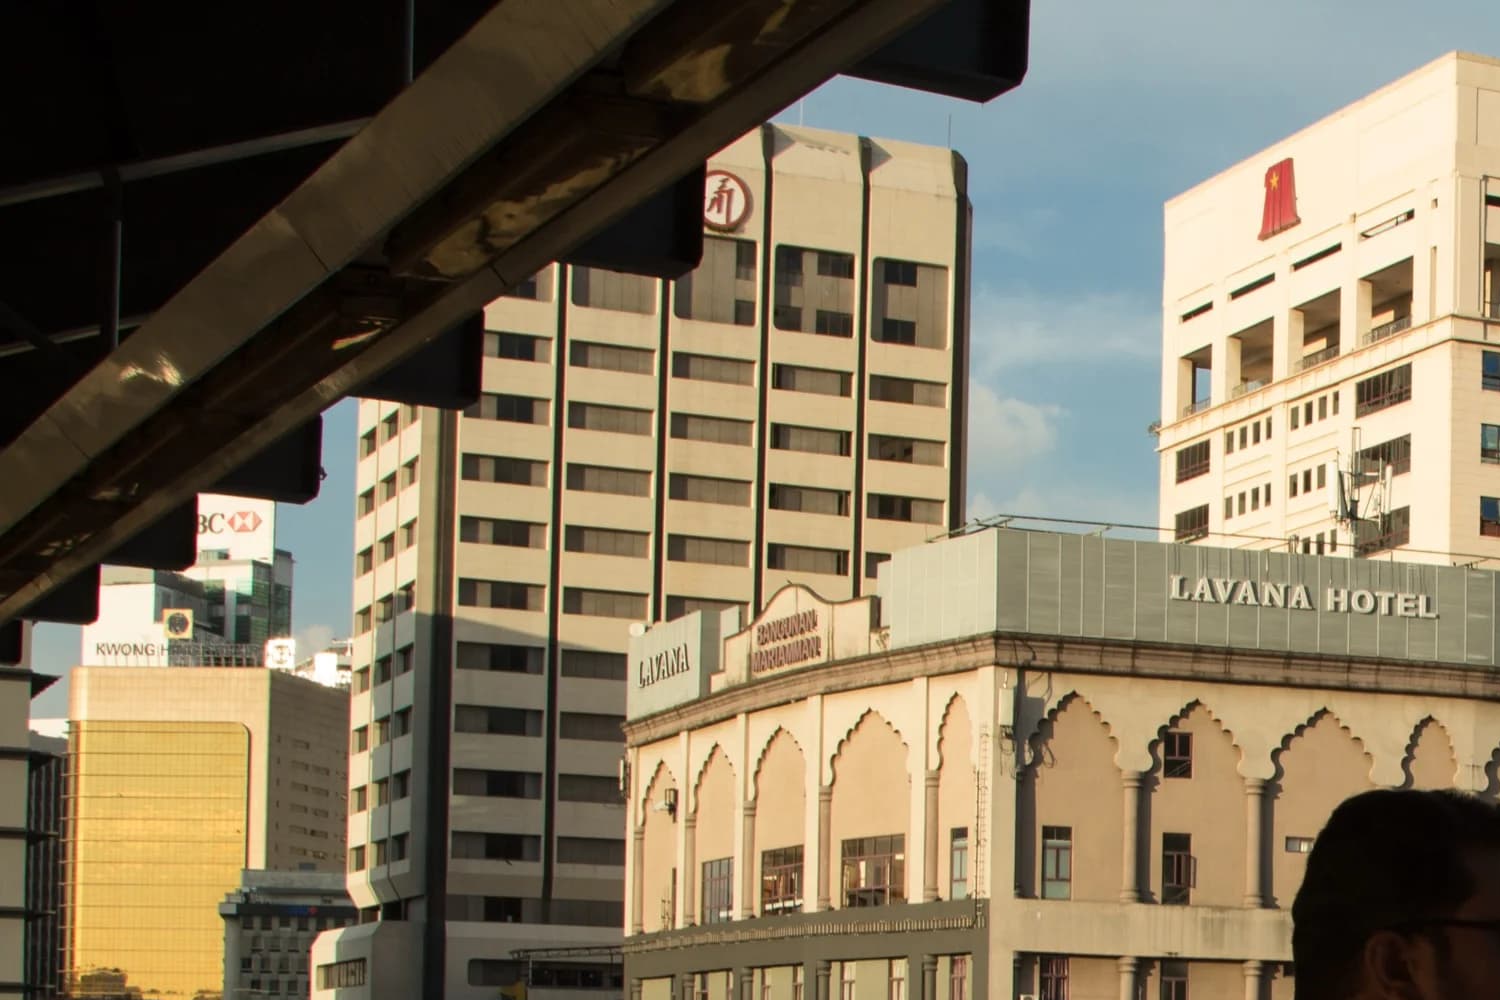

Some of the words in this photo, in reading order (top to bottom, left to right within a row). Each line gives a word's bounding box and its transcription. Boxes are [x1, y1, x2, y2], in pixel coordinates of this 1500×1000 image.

[1169, 574, 1315, 611] LAVANA
[1327, 587, 1439, 619] HOTEL
[96, 642, 156, 657] KWONG
[638, 642, 690, 689] LAVANA
